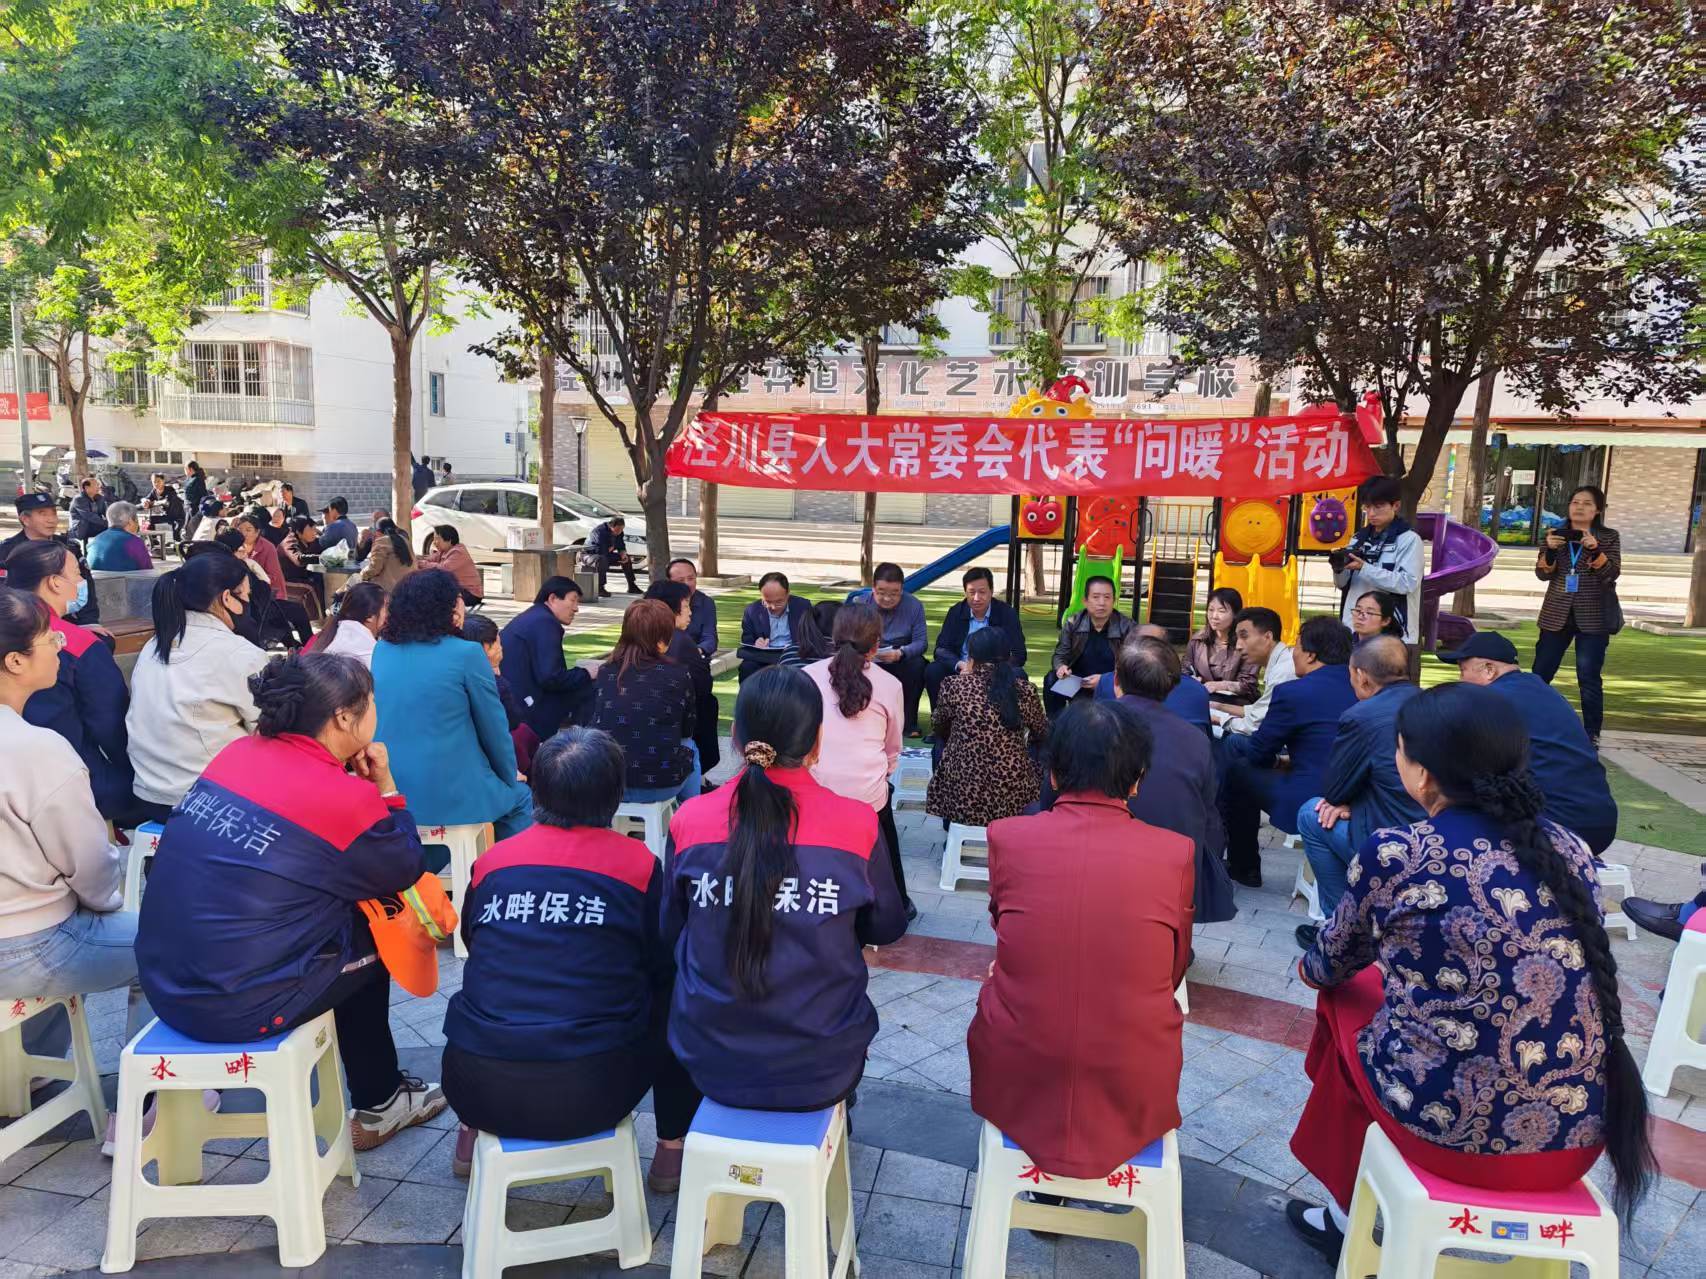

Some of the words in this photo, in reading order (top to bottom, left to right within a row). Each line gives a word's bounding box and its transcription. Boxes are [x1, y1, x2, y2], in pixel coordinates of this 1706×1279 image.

[478, 890, 607, 926] 水畔保洁
[691, 871, 841, 916] 水保洁
[151, 1056, 177, 1081] 水
[225, 1052, 257, 1083] 畔
[1107, 1164, 1141, 1198] 畔
[1448, 1207, 1483, 1235] 水
[1539, 1217, 1575, 1248] 畔
